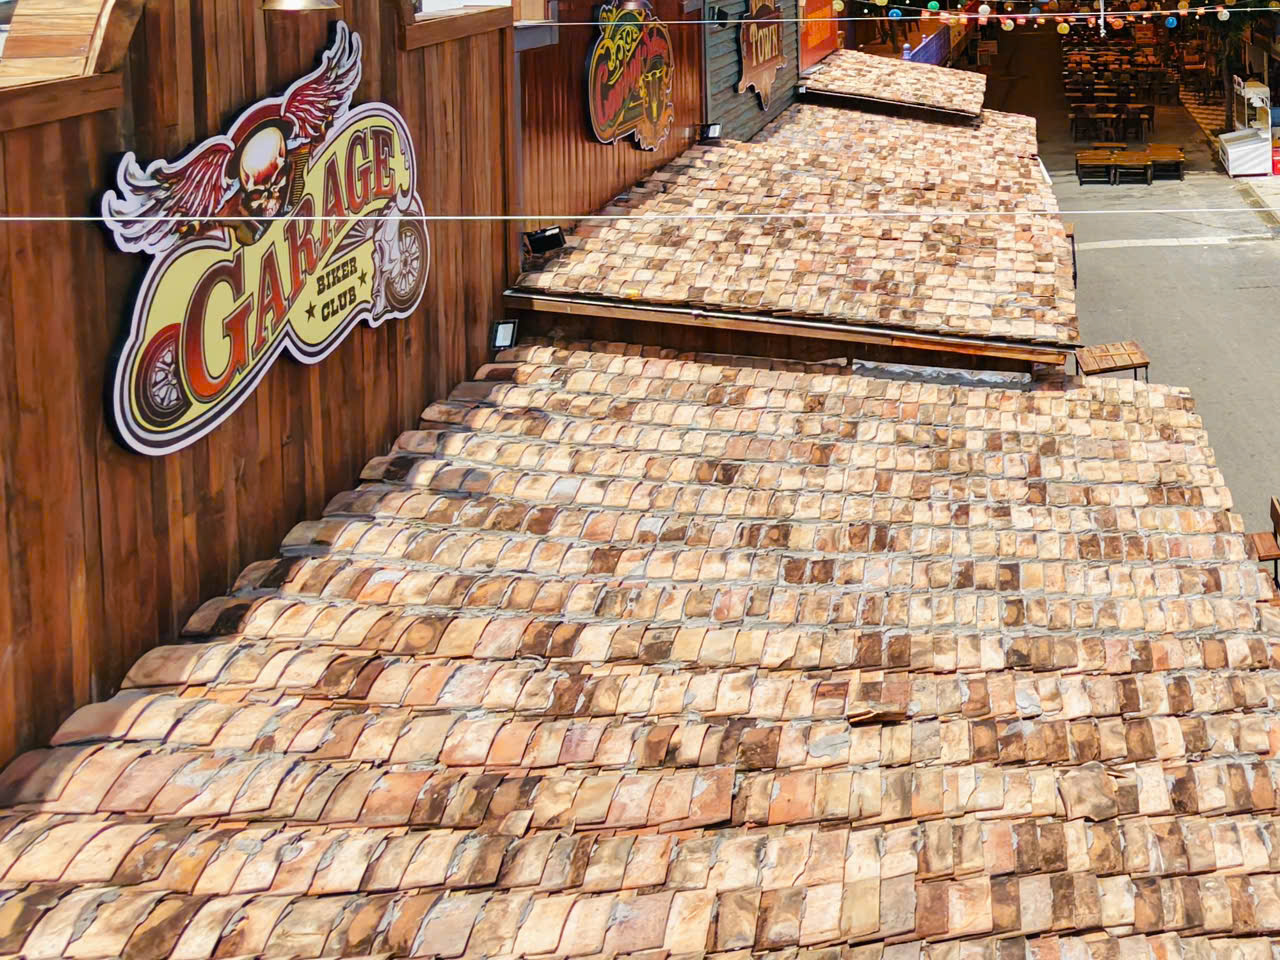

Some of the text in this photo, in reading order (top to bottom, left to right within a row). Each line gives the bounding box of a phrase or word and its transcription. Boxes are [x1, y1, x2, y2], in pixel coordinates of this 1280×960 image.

[750, 23, 778, 67] TOWN
[181, 125, 397, 404] GARAGE
[316, 256, 358, 296] BIKER
[321, 286, 357, 321] CLUB
